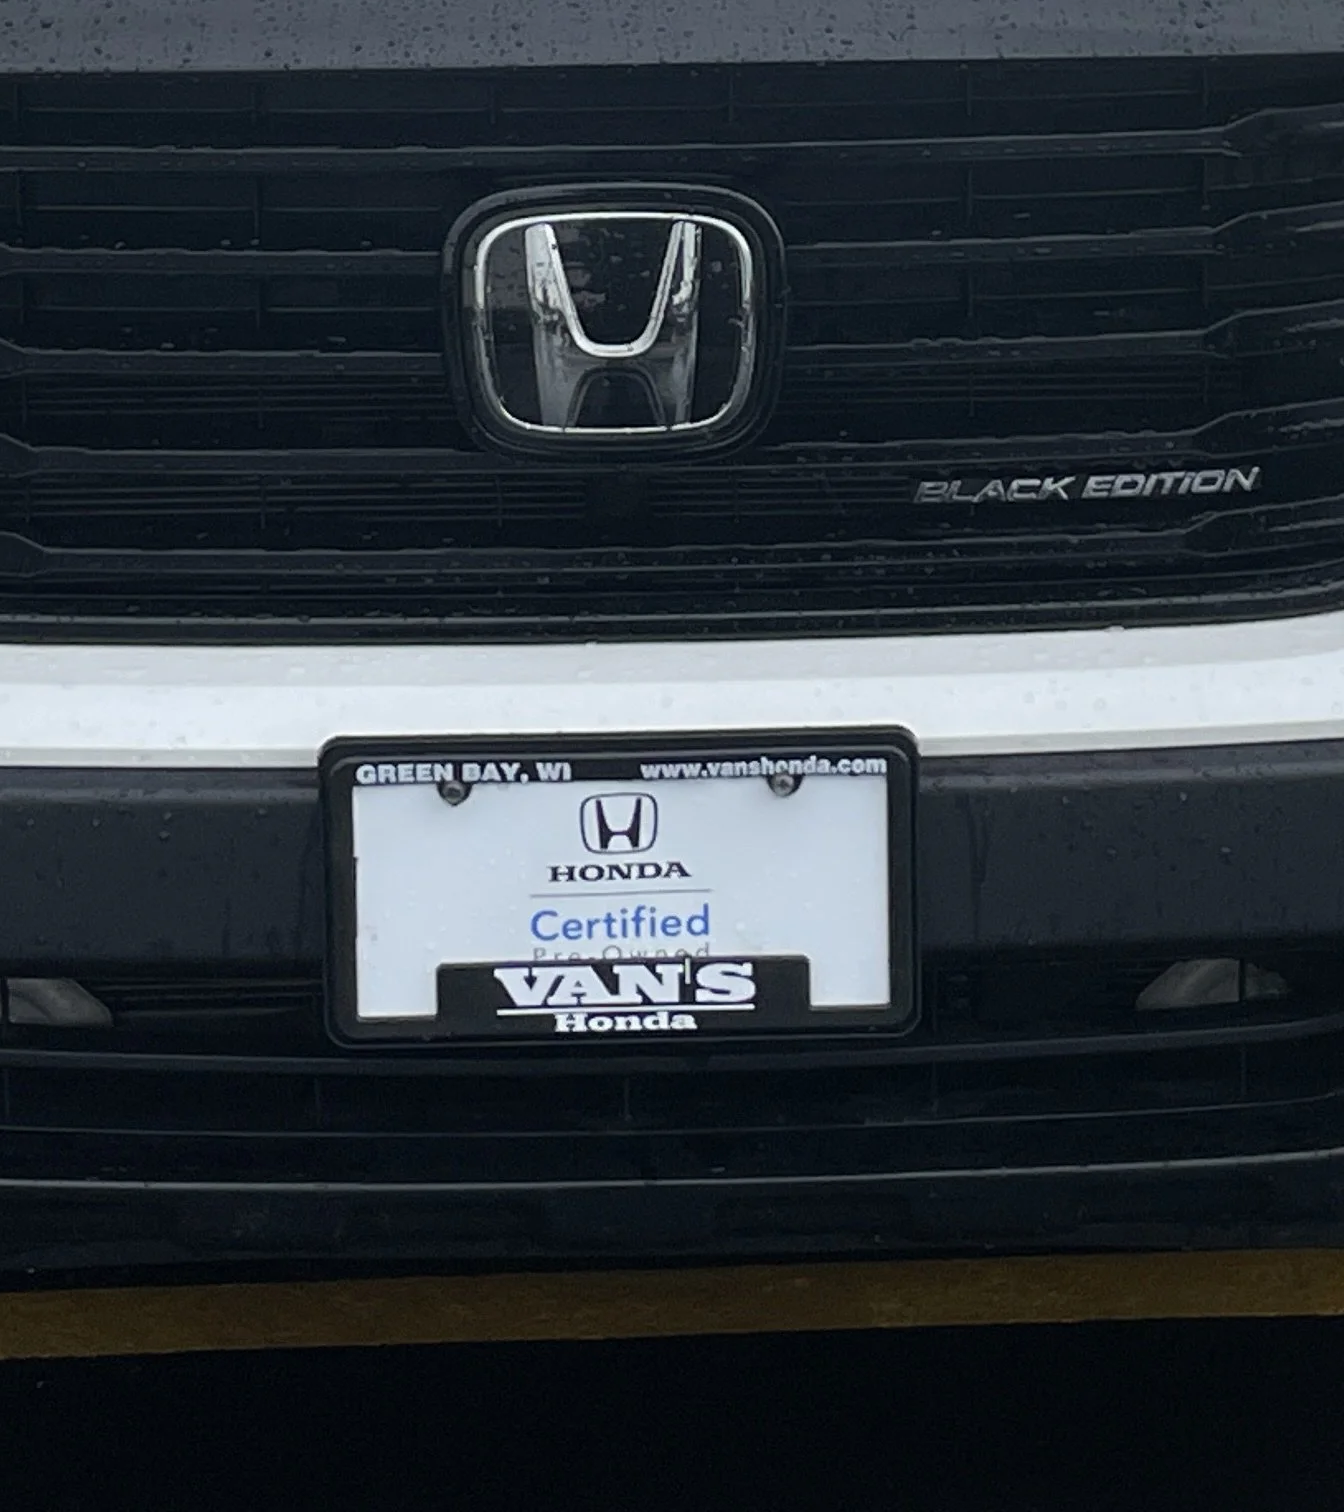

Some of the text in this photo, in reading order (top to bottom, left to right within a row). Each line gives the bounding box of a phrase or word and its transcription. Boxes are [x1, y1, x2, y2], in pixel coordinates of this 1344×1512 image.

[913, 466, 1260, 503] BLACK EDITION
[356, 761, 572, 785] GREEN BAY, WI
[640, 755, 887, 779] www.vanshonda.com
[548, 861, 692, 883] HONDA
[530, 902, 711, 941] Certified
[493, 957, 756, 1007] VAN'S
[554, 1011, 698, 1033] Honda
